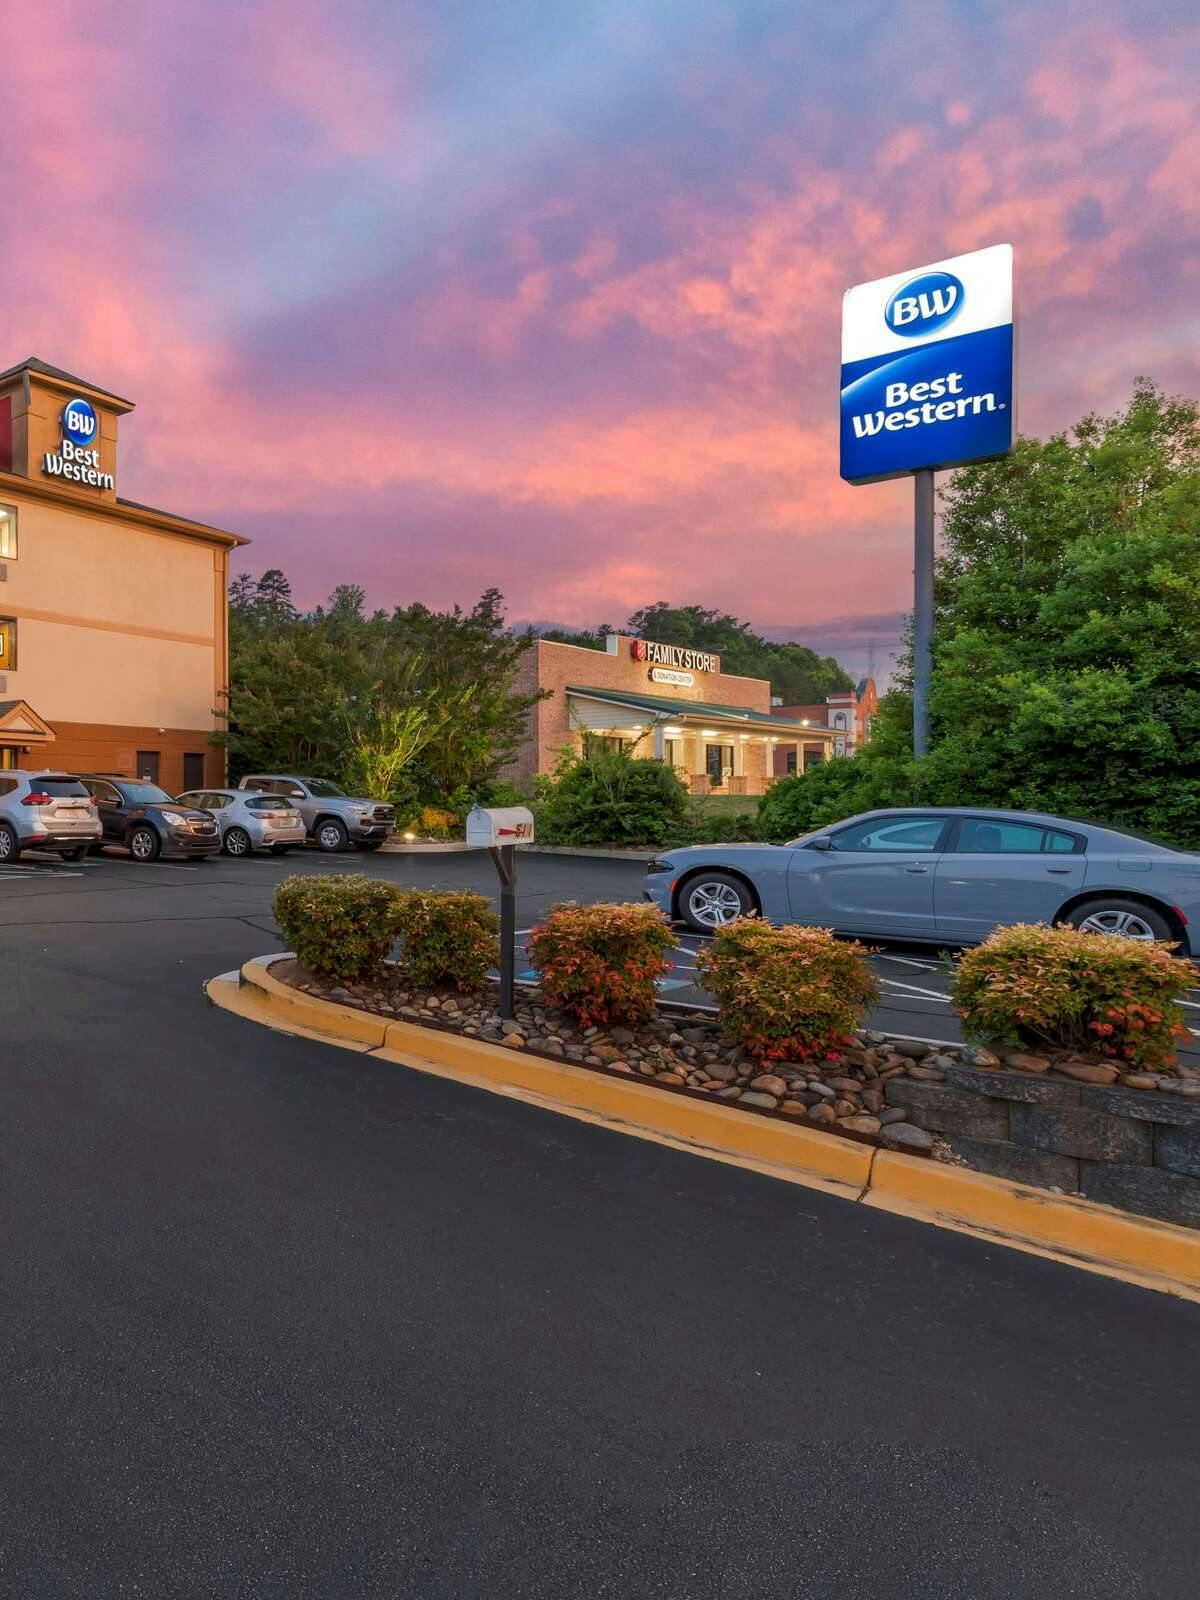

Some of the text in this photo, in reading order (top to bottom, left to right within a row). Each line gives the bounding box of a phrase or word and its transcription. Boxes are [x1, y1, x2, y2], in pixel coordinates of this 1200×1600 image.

[893, 286, 957, 326] BW
[886, 372, 963, 408] Best
[68, 410, 94, 435] BW
[62, 439, 99, 468] Best
[45, 452, 114, 490] Western
[647, 642, 716, 673] FAMILY STORE
